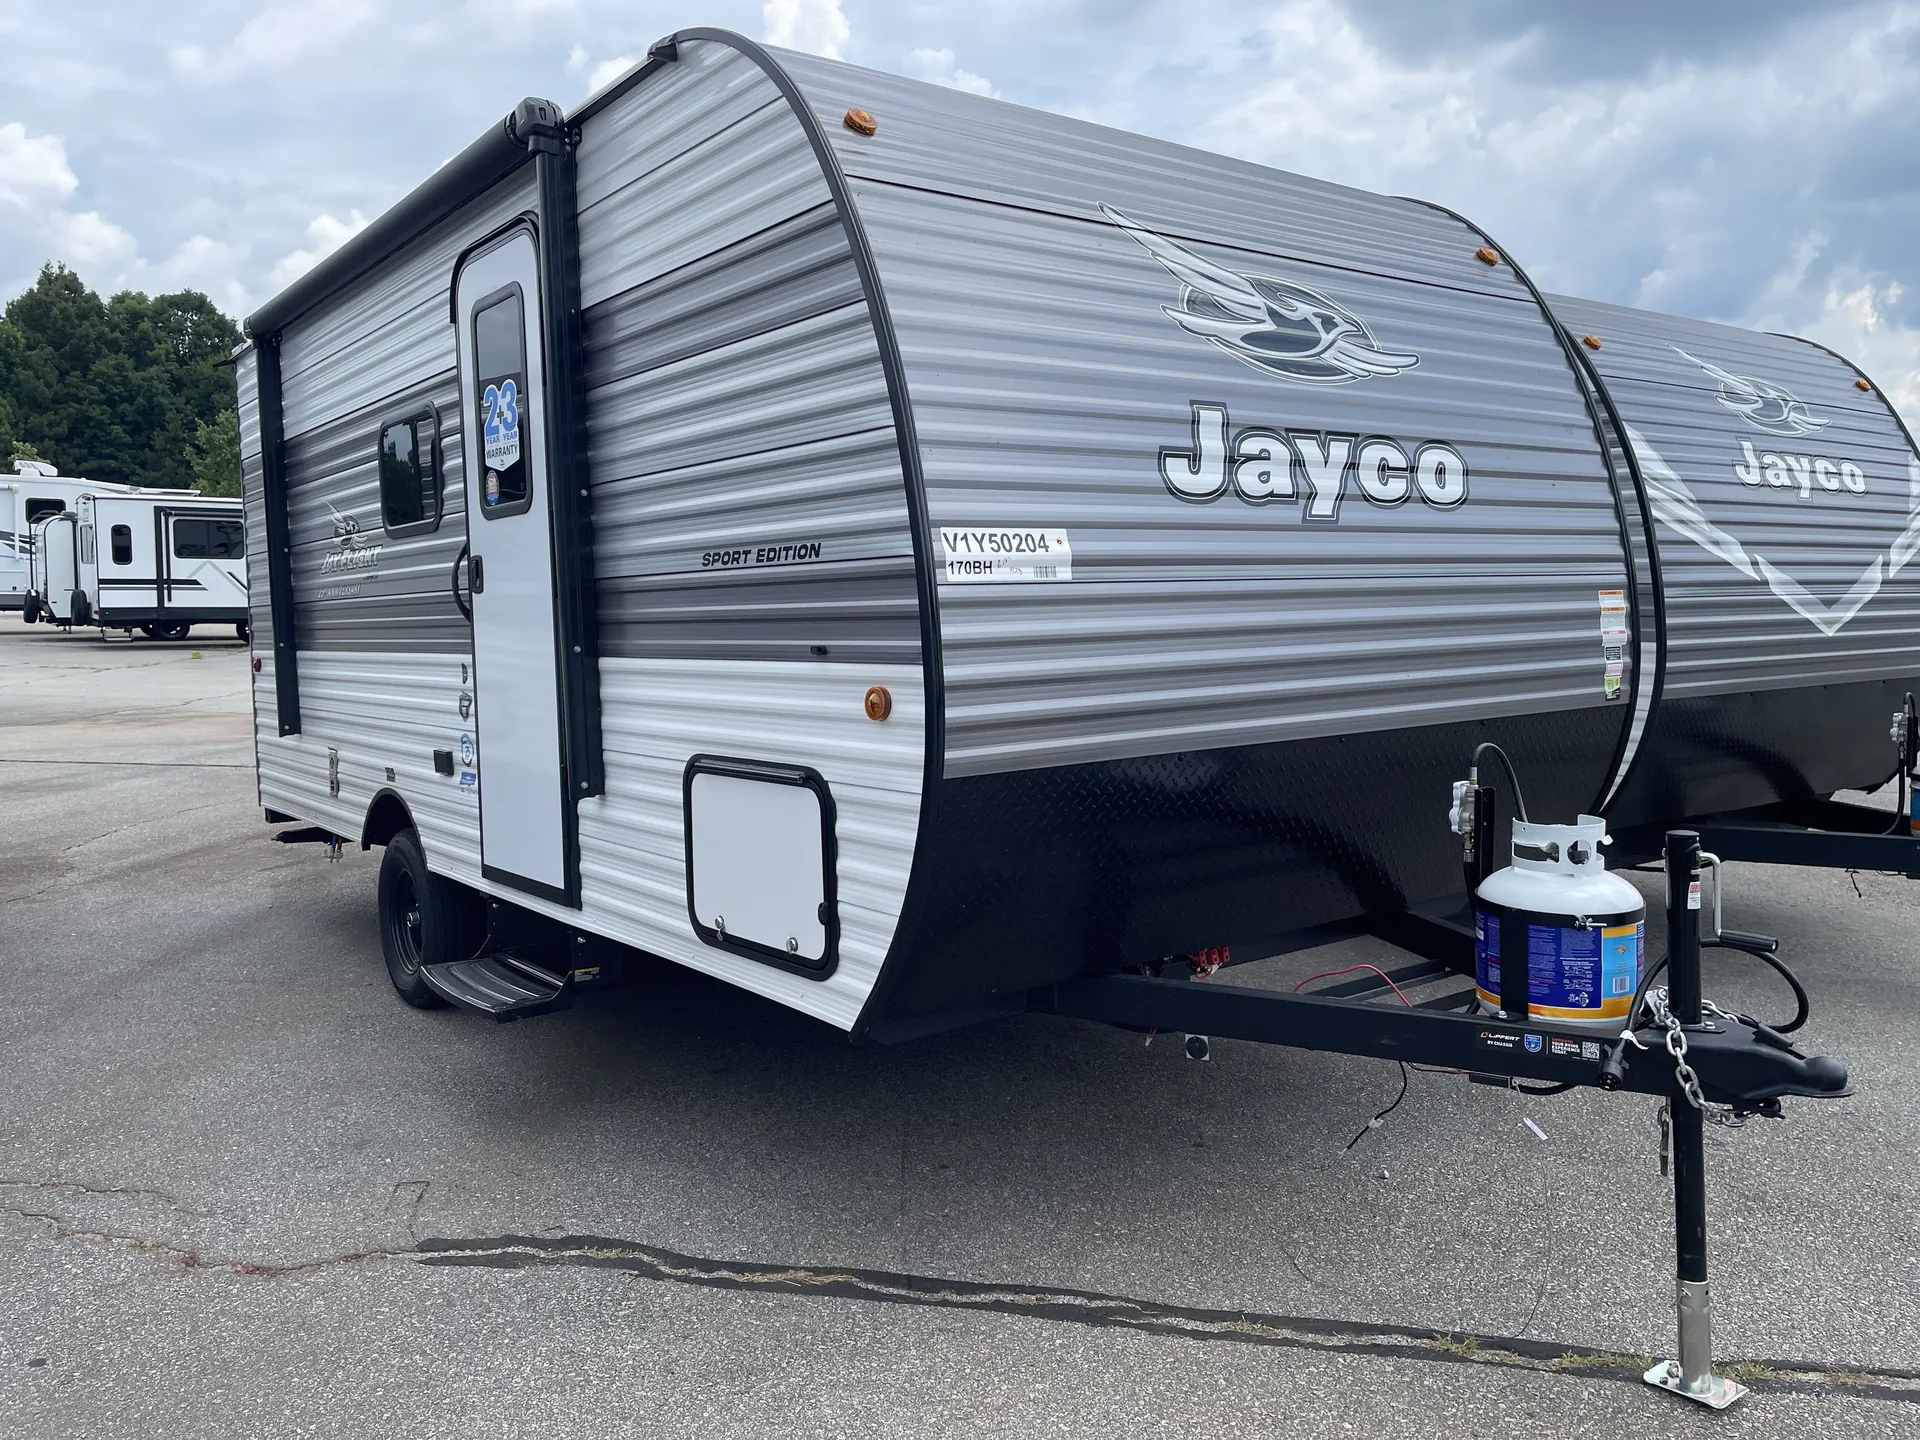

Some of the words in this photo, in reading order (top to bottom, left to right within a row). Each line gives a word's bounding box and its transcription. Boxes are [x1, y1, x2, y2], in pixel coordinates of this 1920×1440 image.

[486, 435, 500, 445] YEAR
[503, 430, 518, 441] YEAR
[486, 444, 518, 459] WARRANTY
[1158, 399, 1469, 524] Jayco
[1732, 436, 1868, 500] Jayco
[942, 532, 1050, 553] V1Y50204
[702, 549, 752, 567] SPORT
[756, 542, 822, 563] EDITION
[948, 560, 993, 575] 170BH
